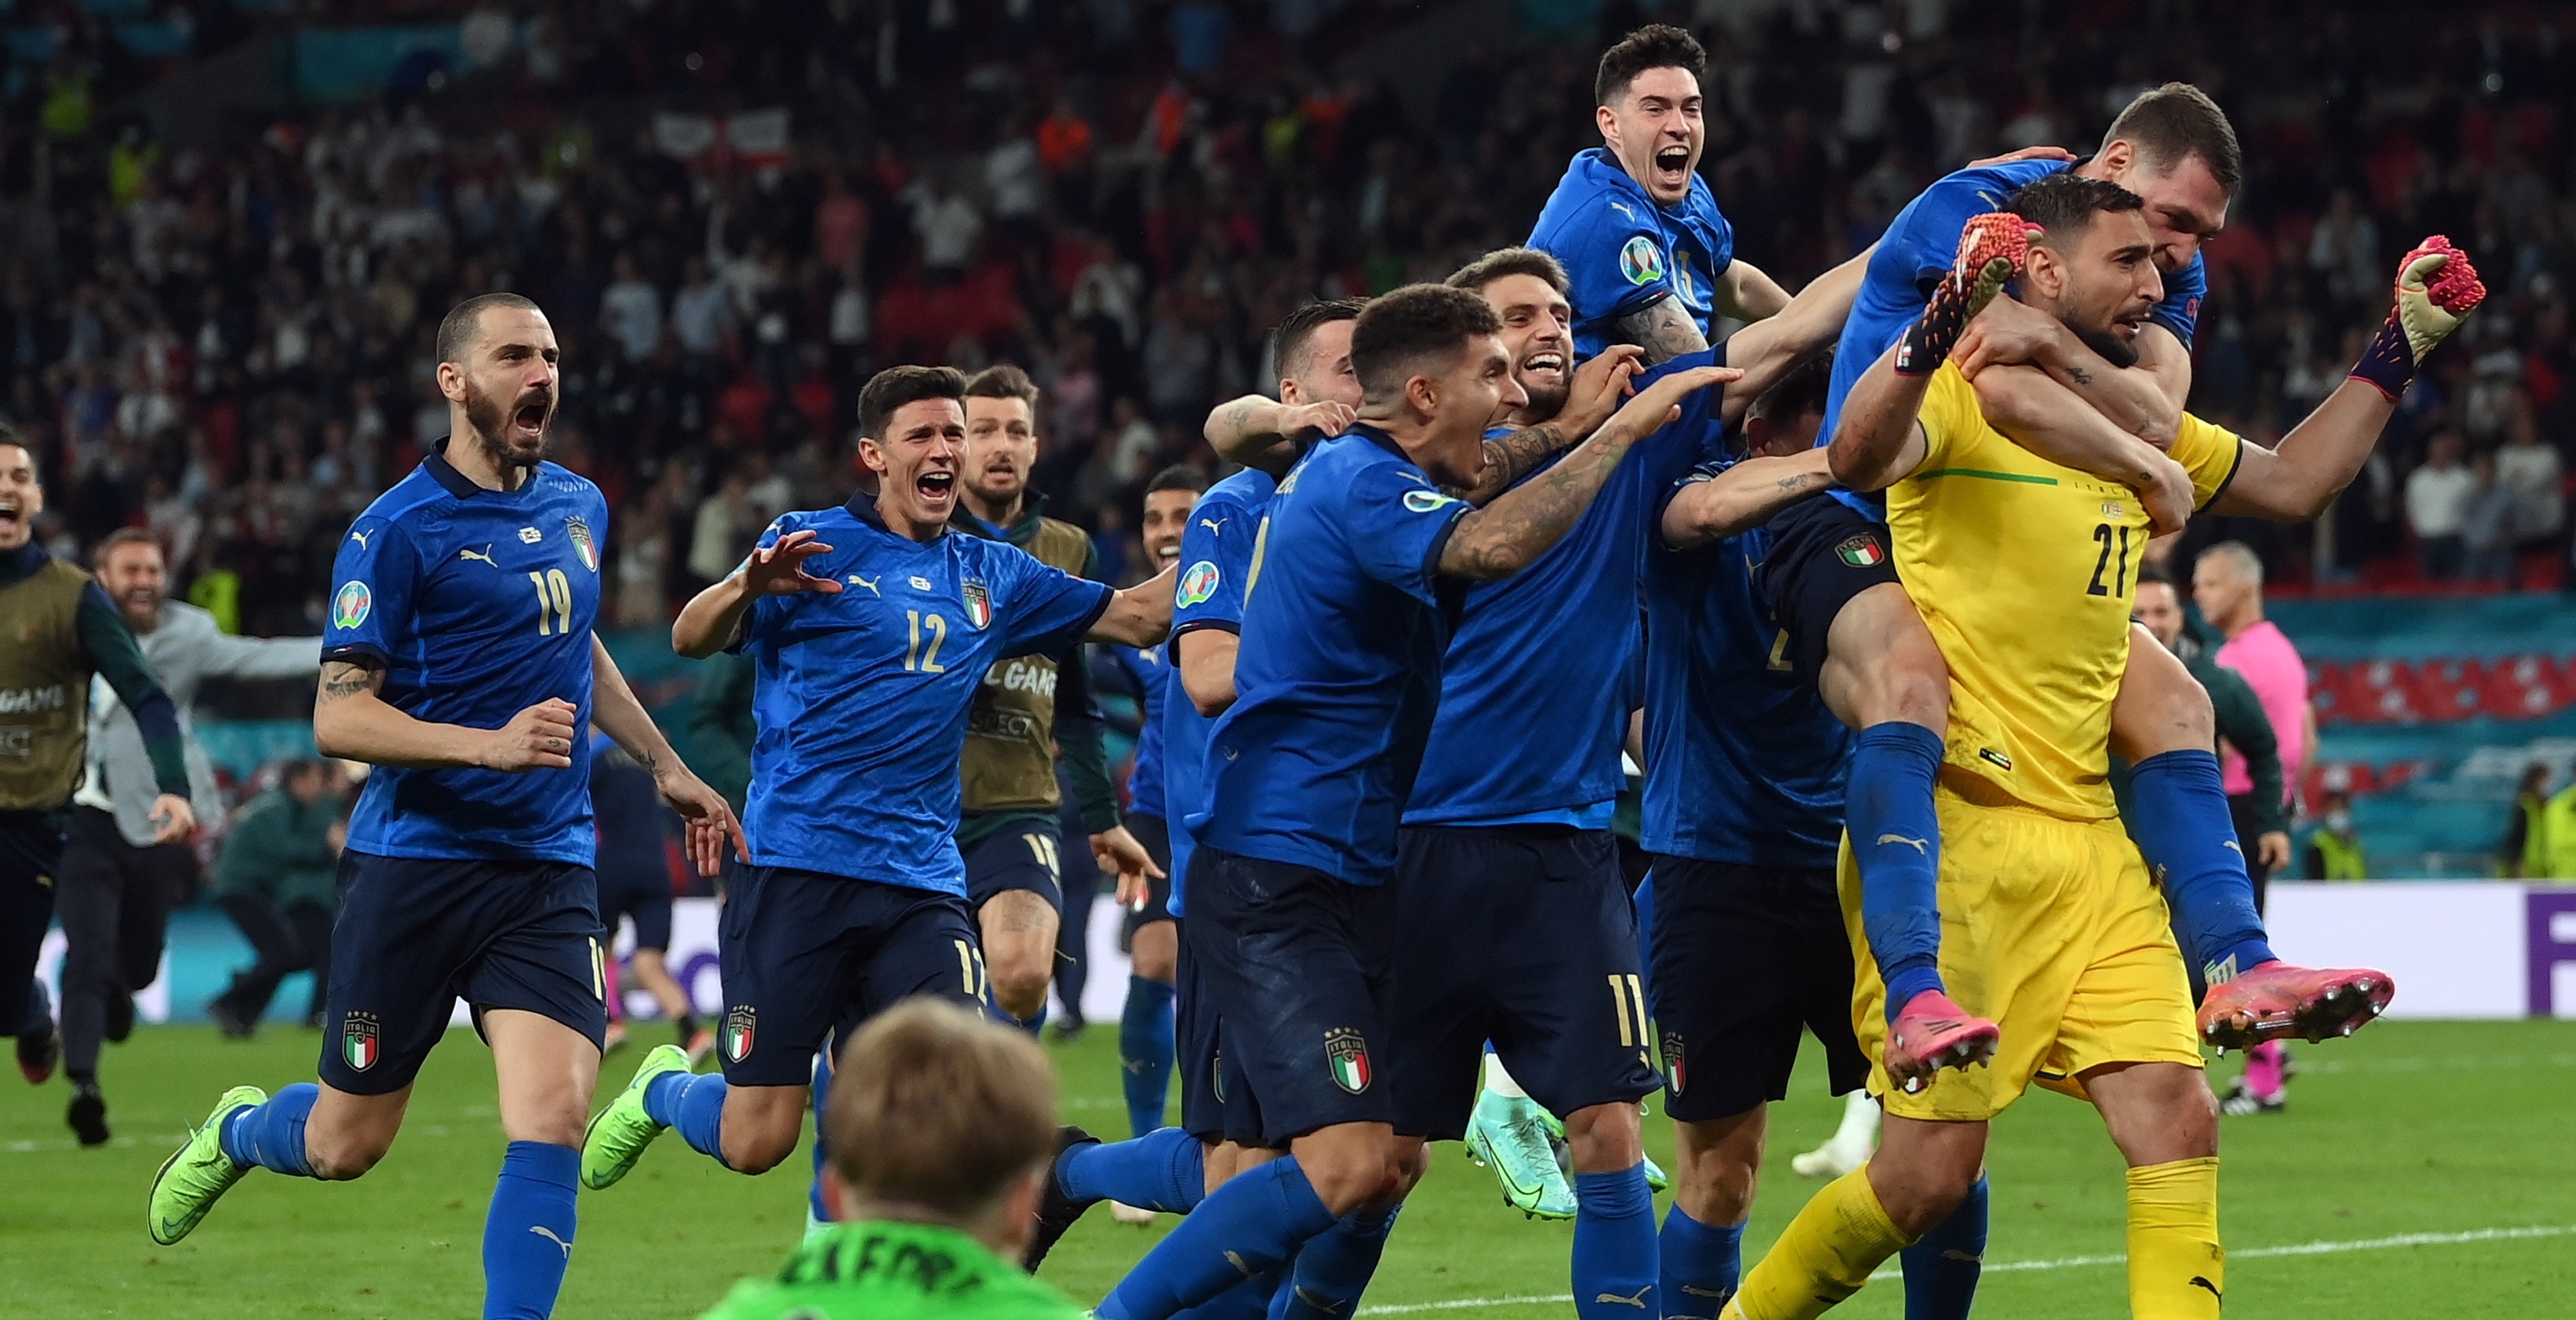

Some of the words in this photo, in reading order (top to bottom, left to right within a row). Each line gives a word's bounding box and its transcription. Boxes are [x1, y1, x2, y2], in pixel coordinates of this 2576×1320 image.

[2086, 523, 2130, 598] 21
[529, 569, 571, 636] 19
[905, 609, 946, 673] 12
[954, 939, 988, 1006] 12
[347, 1024, 375, 1033] ITALIA
[731, 1017, 752, 1026] ITALIA
[1607, 974, 1649, 1046] 11
[1330, 1040, 1361, 1052] ITALIA
